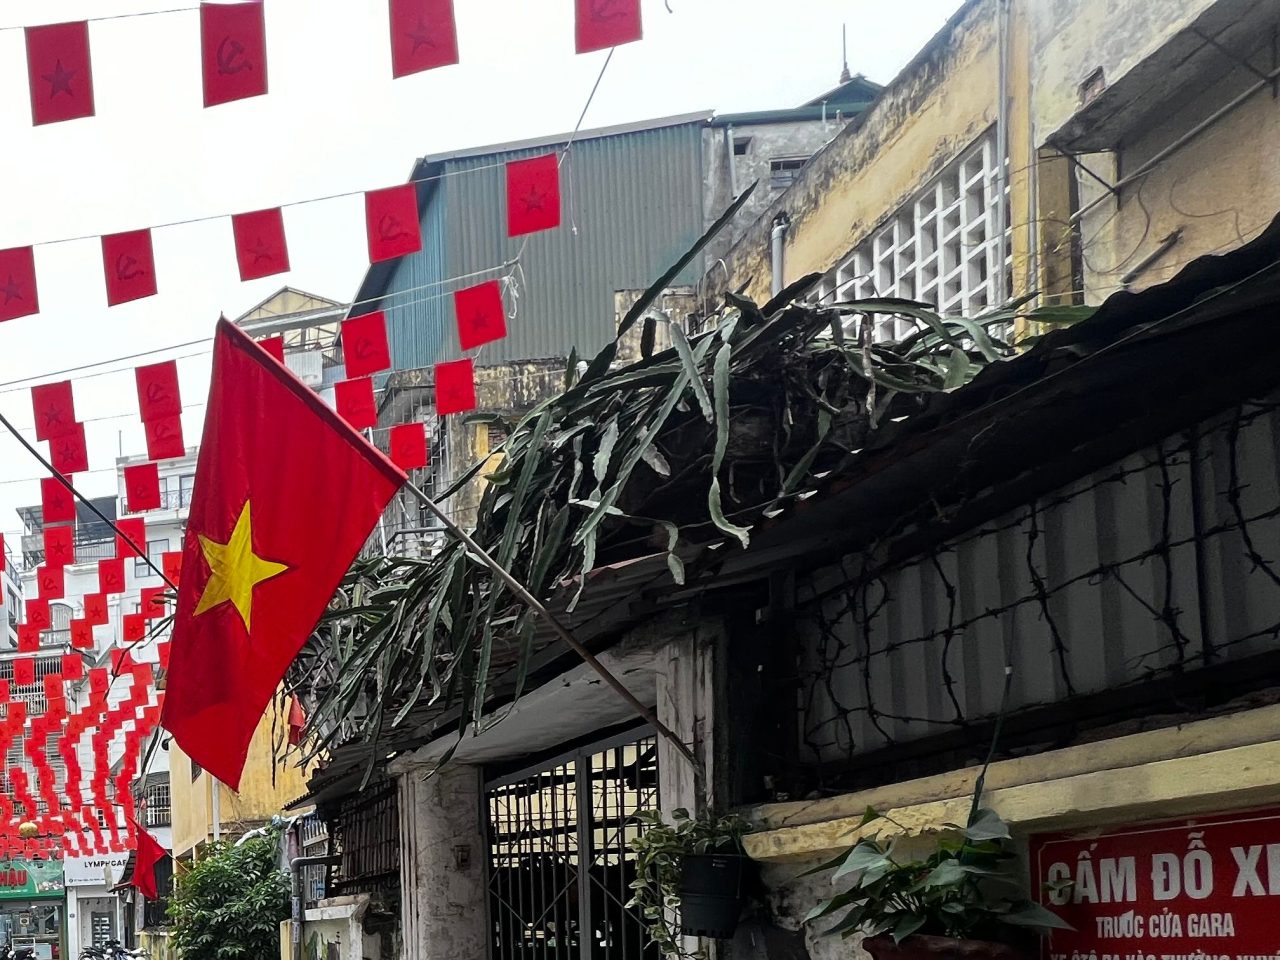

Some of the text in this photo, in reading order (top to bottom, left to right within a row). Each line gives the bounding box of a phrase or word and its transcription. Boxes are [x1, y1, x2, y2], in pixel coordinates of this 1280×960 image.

[1048, 843, 1137, 905] CẤM
[1151, 831, 1214, 901] ĐỖ
[1149, 907, 1183, 938] CỬA
[1187, 912, 1235, 938] GARA
